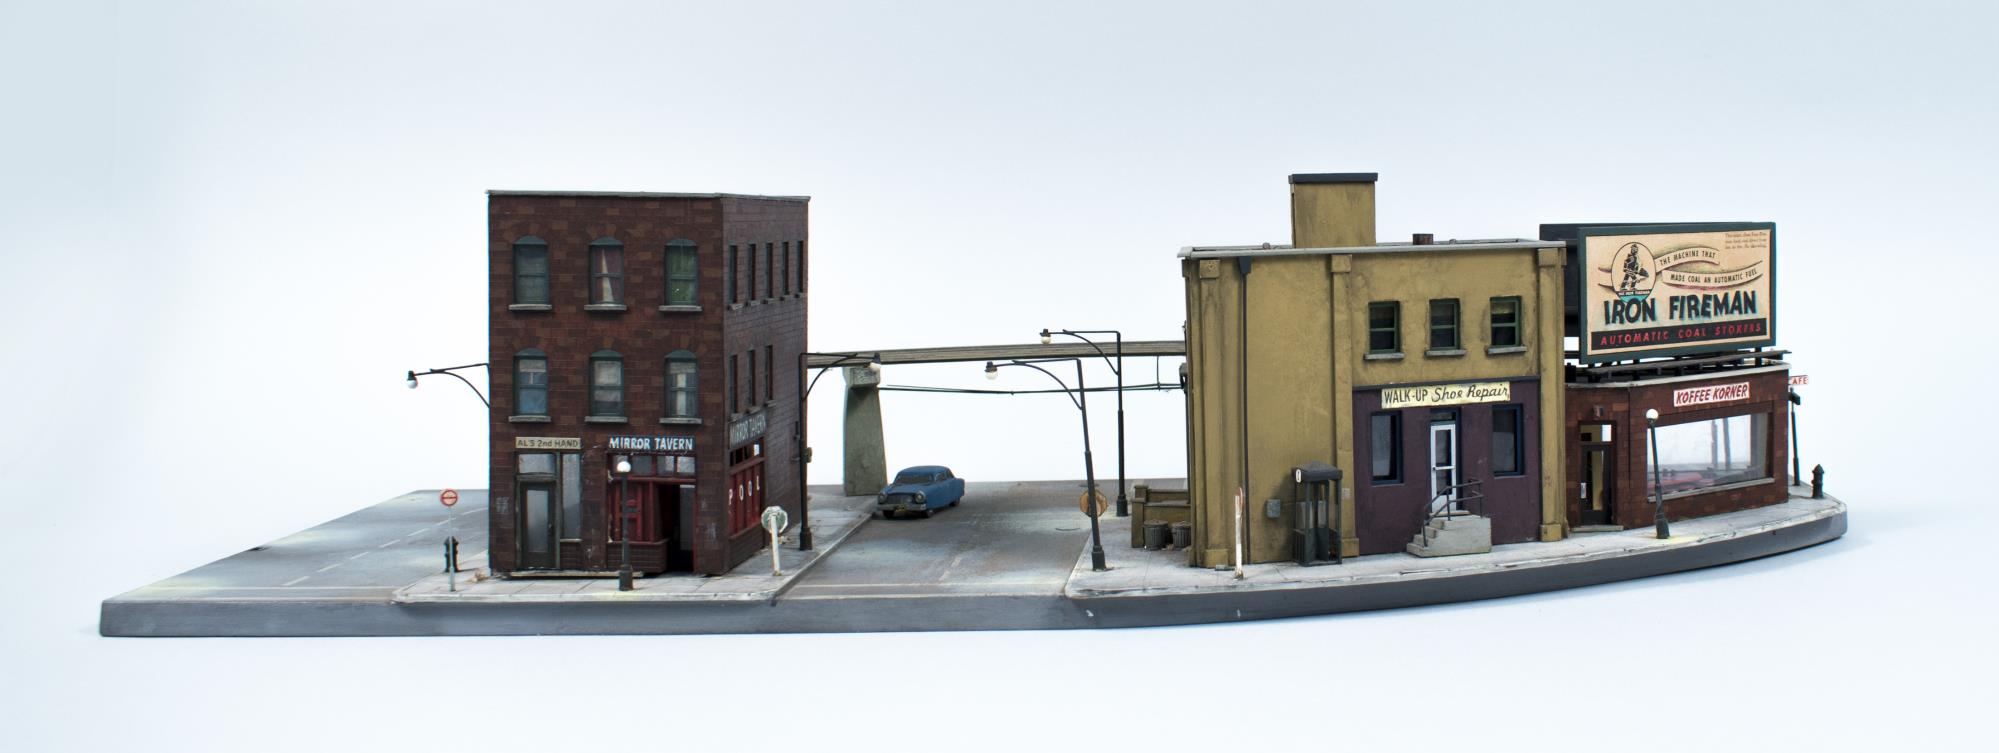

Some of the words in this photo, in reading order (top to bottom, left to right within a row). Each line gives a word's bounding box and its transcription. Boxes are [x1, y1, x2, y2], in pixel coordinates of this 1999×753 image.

[1660, 256, 1671, 266] THE
[1673, 250, 1699, 261] MACHINE
[1702, 250, 1716, 259] THAT
[1670, 273, 1685, 281] MADE
[1687, 275, 1701, 283] COAL
[1714, 274, 1743, 283] AUTOMATIC
[1745, 268, 1758, 277] FUEL
[1604, 298, 1656, 325] IRON
[1669, 290, 1757, 320] FIREMAN
[1600, 331, 1669, 345] AUTOMATIC
[1678, 326, 1707, 339] COAL
[1714, 322, 1761, 336] STOKERS
[1792, 376, 1808, 385] AFE
[1384, 389, 1429, 403] WALK-UP
[1431, 387, 1463, 403] Shoe
[1467, 383, 1509, 402] Repair
[1675, 388, 1711, 405] KOFFEE
[1712, 383, 1749, 400] KORNER
[730, 419, 749, 448] MIRROR
[749, 413, 766, 439] TAVERN
[537, 439, 552, 447] 2nd
[554, 440, 579, 448] HAND
[609, 437, 650, 450] MIRROR
[655, 437, 693, 450] TAVERN
[728, 475, 760, 505] POOL
